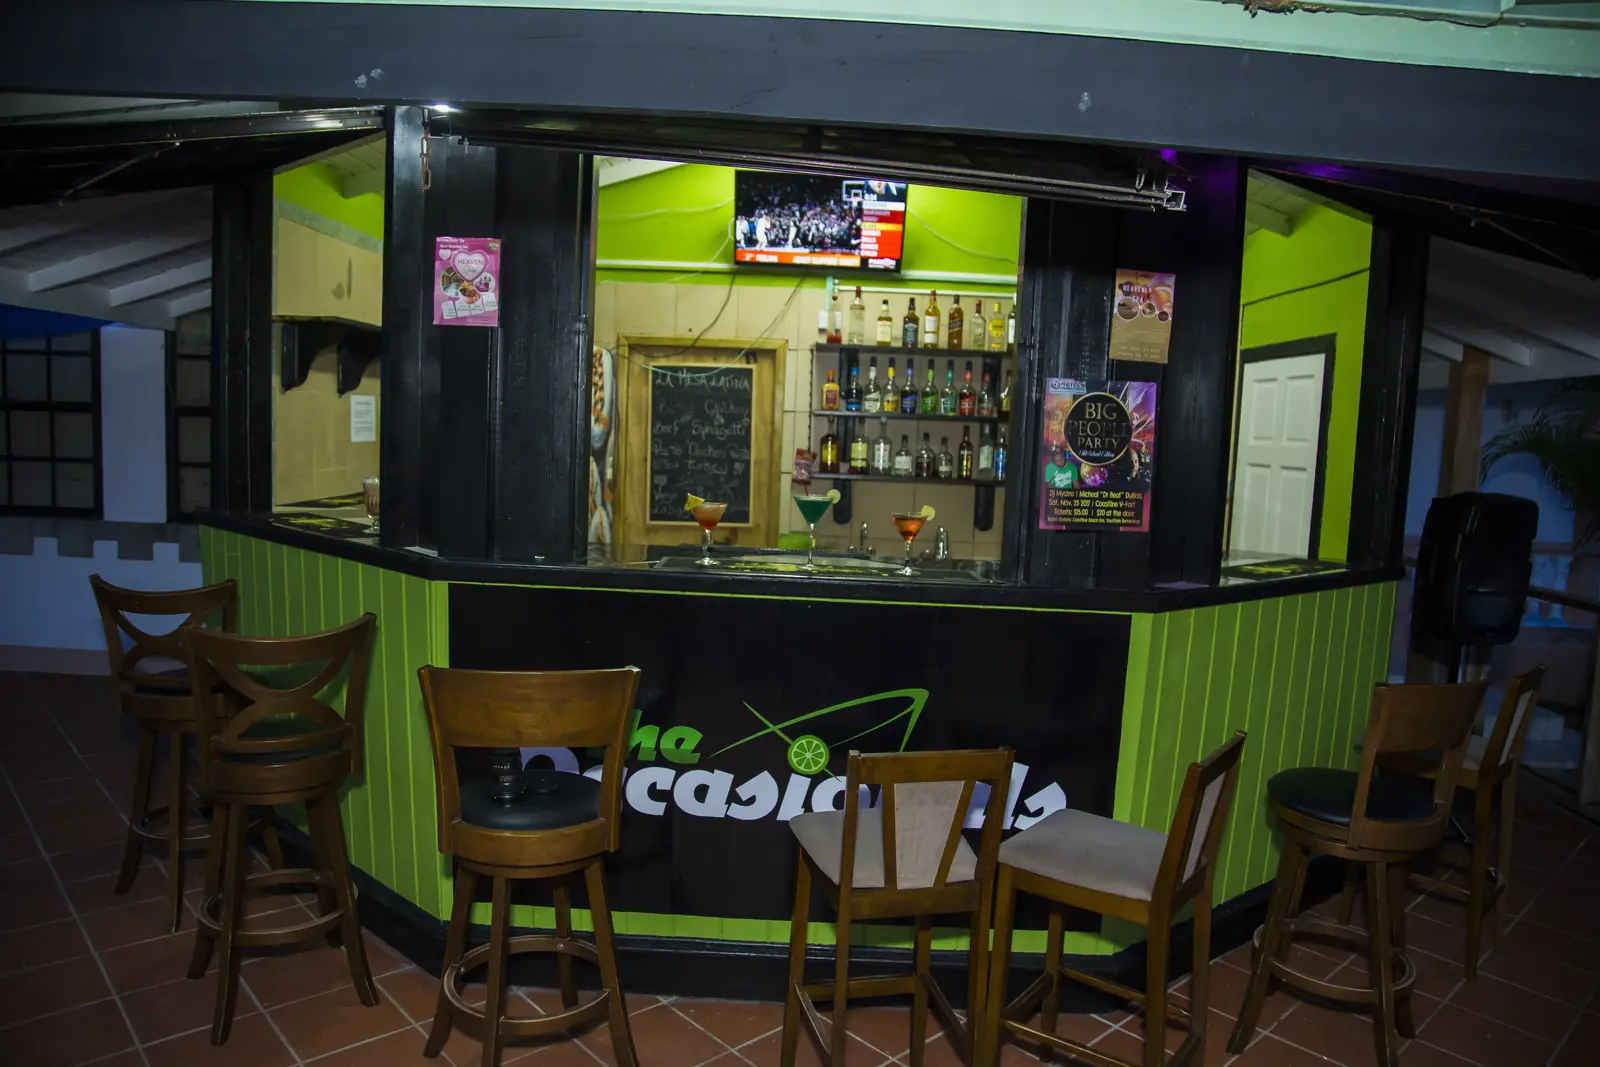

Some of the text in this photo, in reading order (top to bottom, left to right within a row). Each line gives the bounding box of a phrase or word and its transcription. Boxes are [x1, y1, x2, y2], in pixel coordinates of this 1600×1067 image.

[1122, 284, 1152, 293] HEAVENLY
[1085, 402, 1117, 420] BIG
[1068, 420, 1130, 438] PEOPLE
[1078, 437, 1120, 449] PARTY
[626, 709, 704, 764] he
